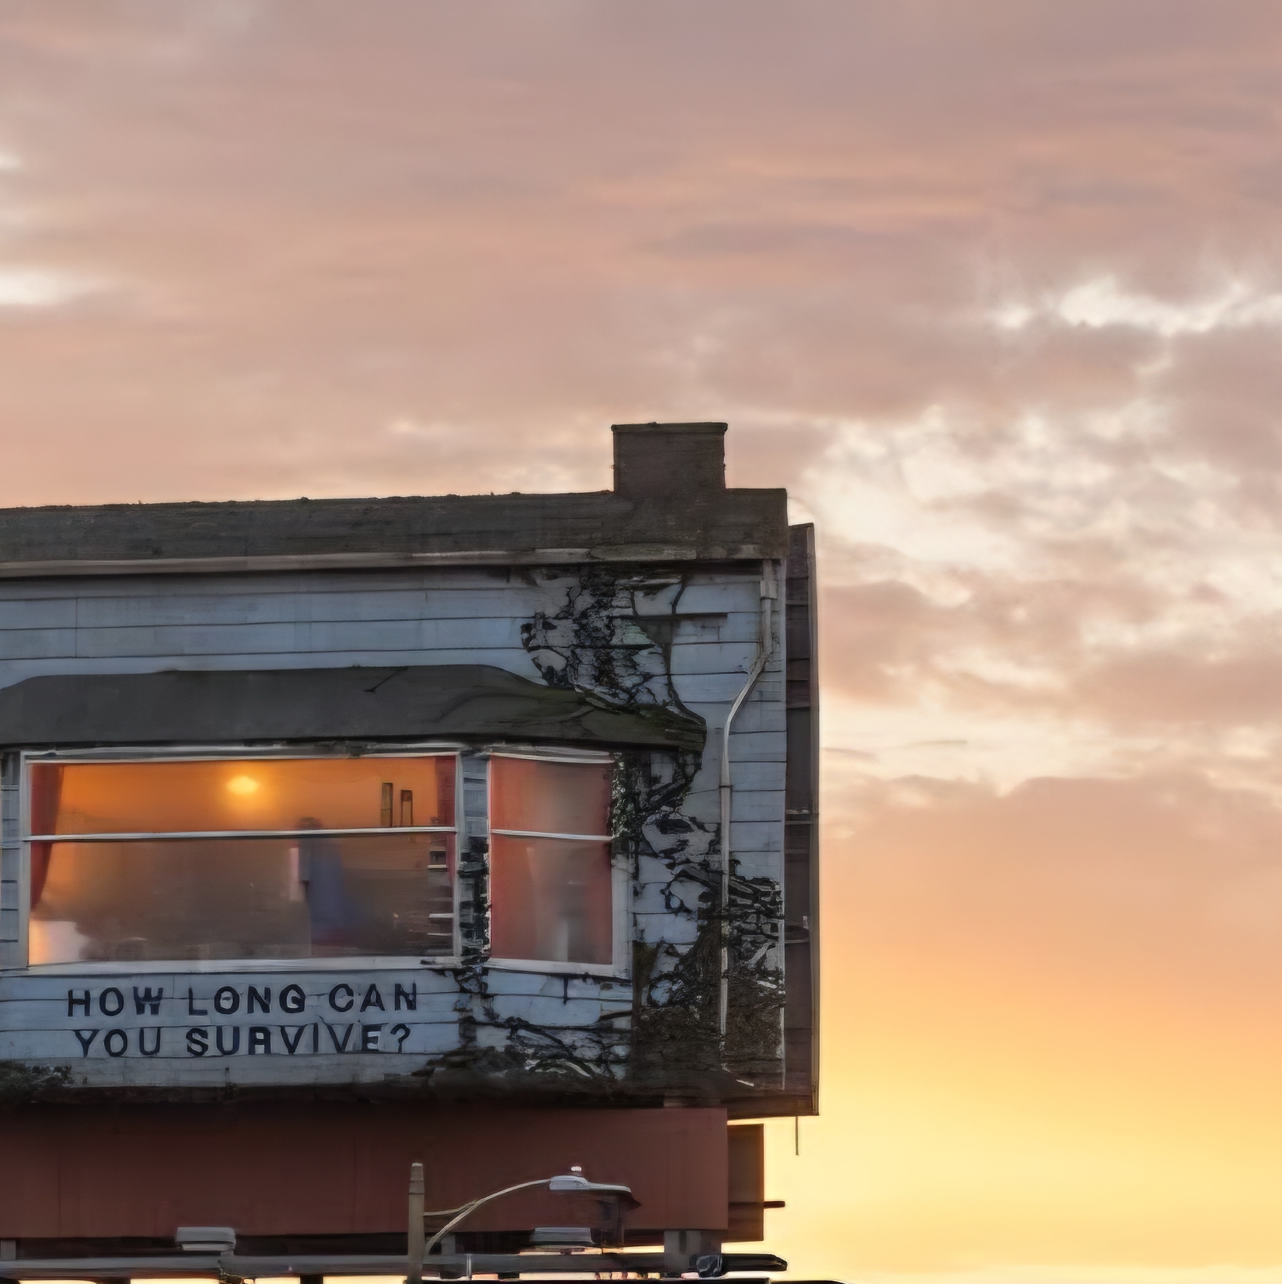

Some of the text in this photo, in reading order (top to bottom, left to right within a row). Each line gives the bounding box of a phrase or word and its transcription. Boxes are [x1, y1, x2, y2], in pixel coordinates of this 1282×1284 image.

[67, 982, 419, 1017] HOW LONG CAN
[73, 1022, 412, 1059] YOU SURVIVE?
